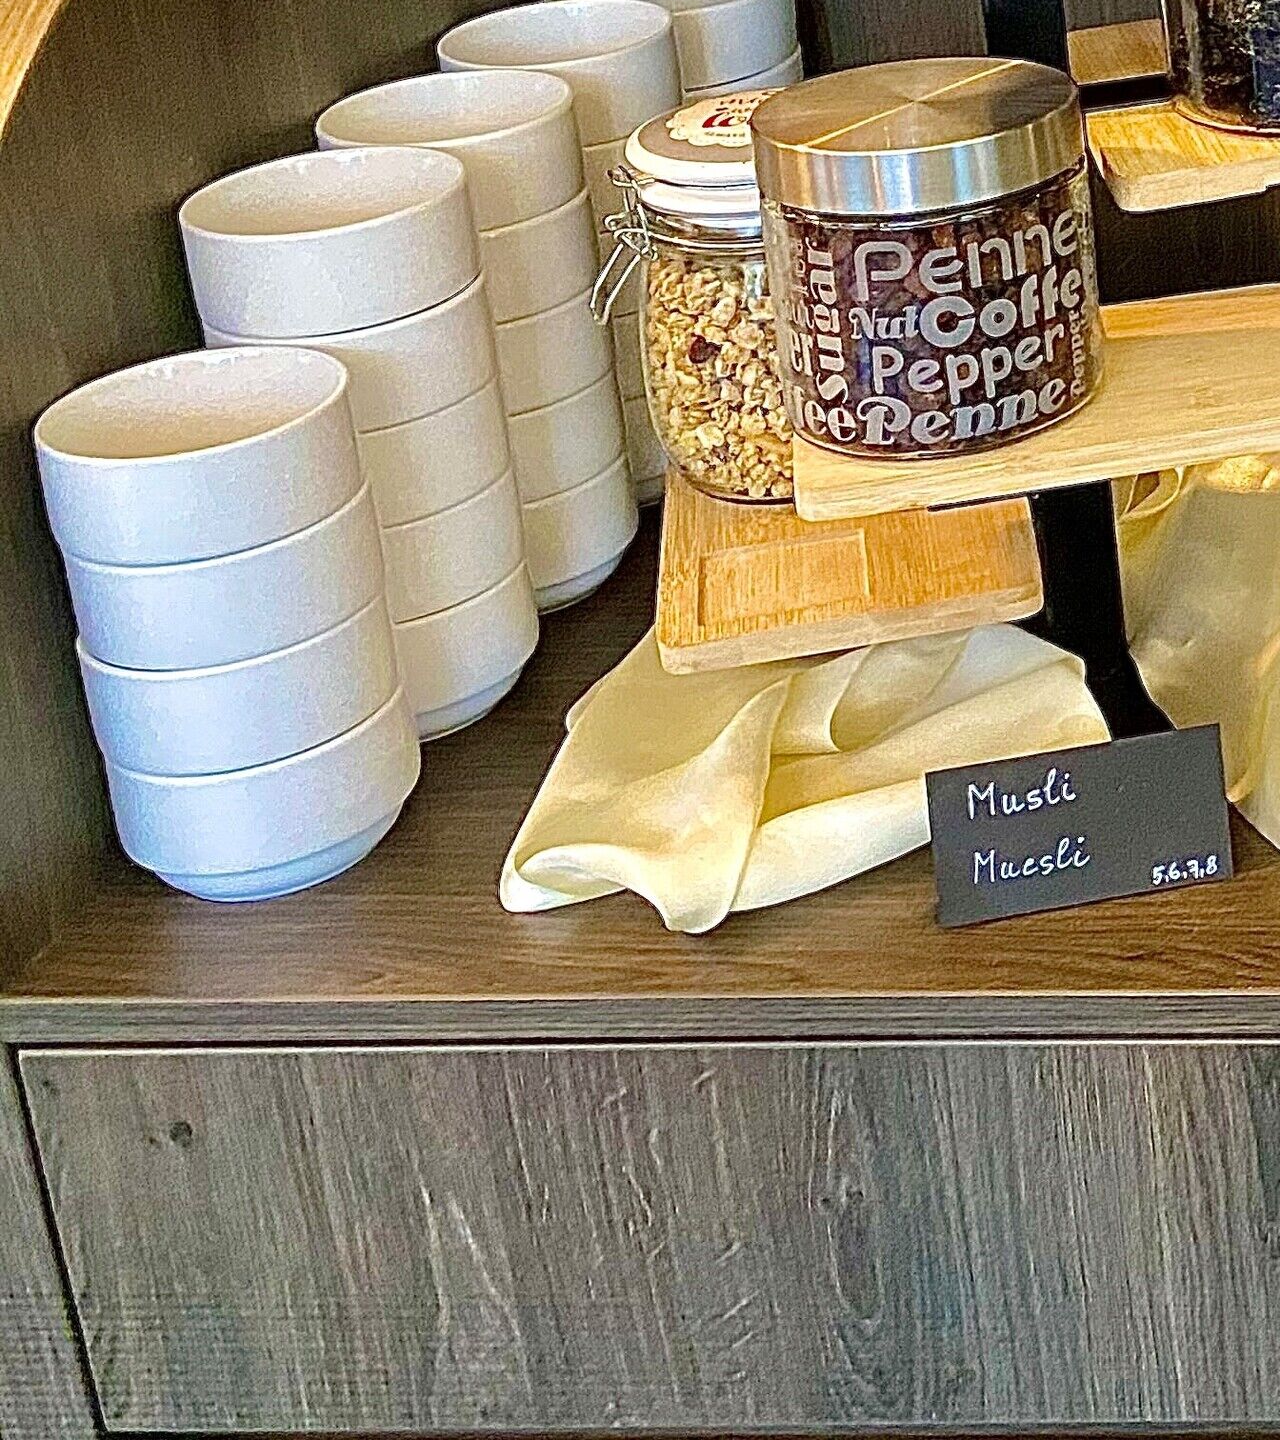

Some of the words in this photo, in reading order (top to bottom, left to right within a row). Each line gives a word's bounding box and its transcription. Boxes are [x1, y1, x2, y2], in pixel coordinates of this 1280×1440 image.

[853, 209, 1080, 302] Penne
[850, 305, 919, 340] Nut
[872, 323, 1065, 405] Pepper
[857, 377, 1067, 446] Penne
[967, 768, 1077, 820] Musli
[973, 836, 1091, 885] Muesli
